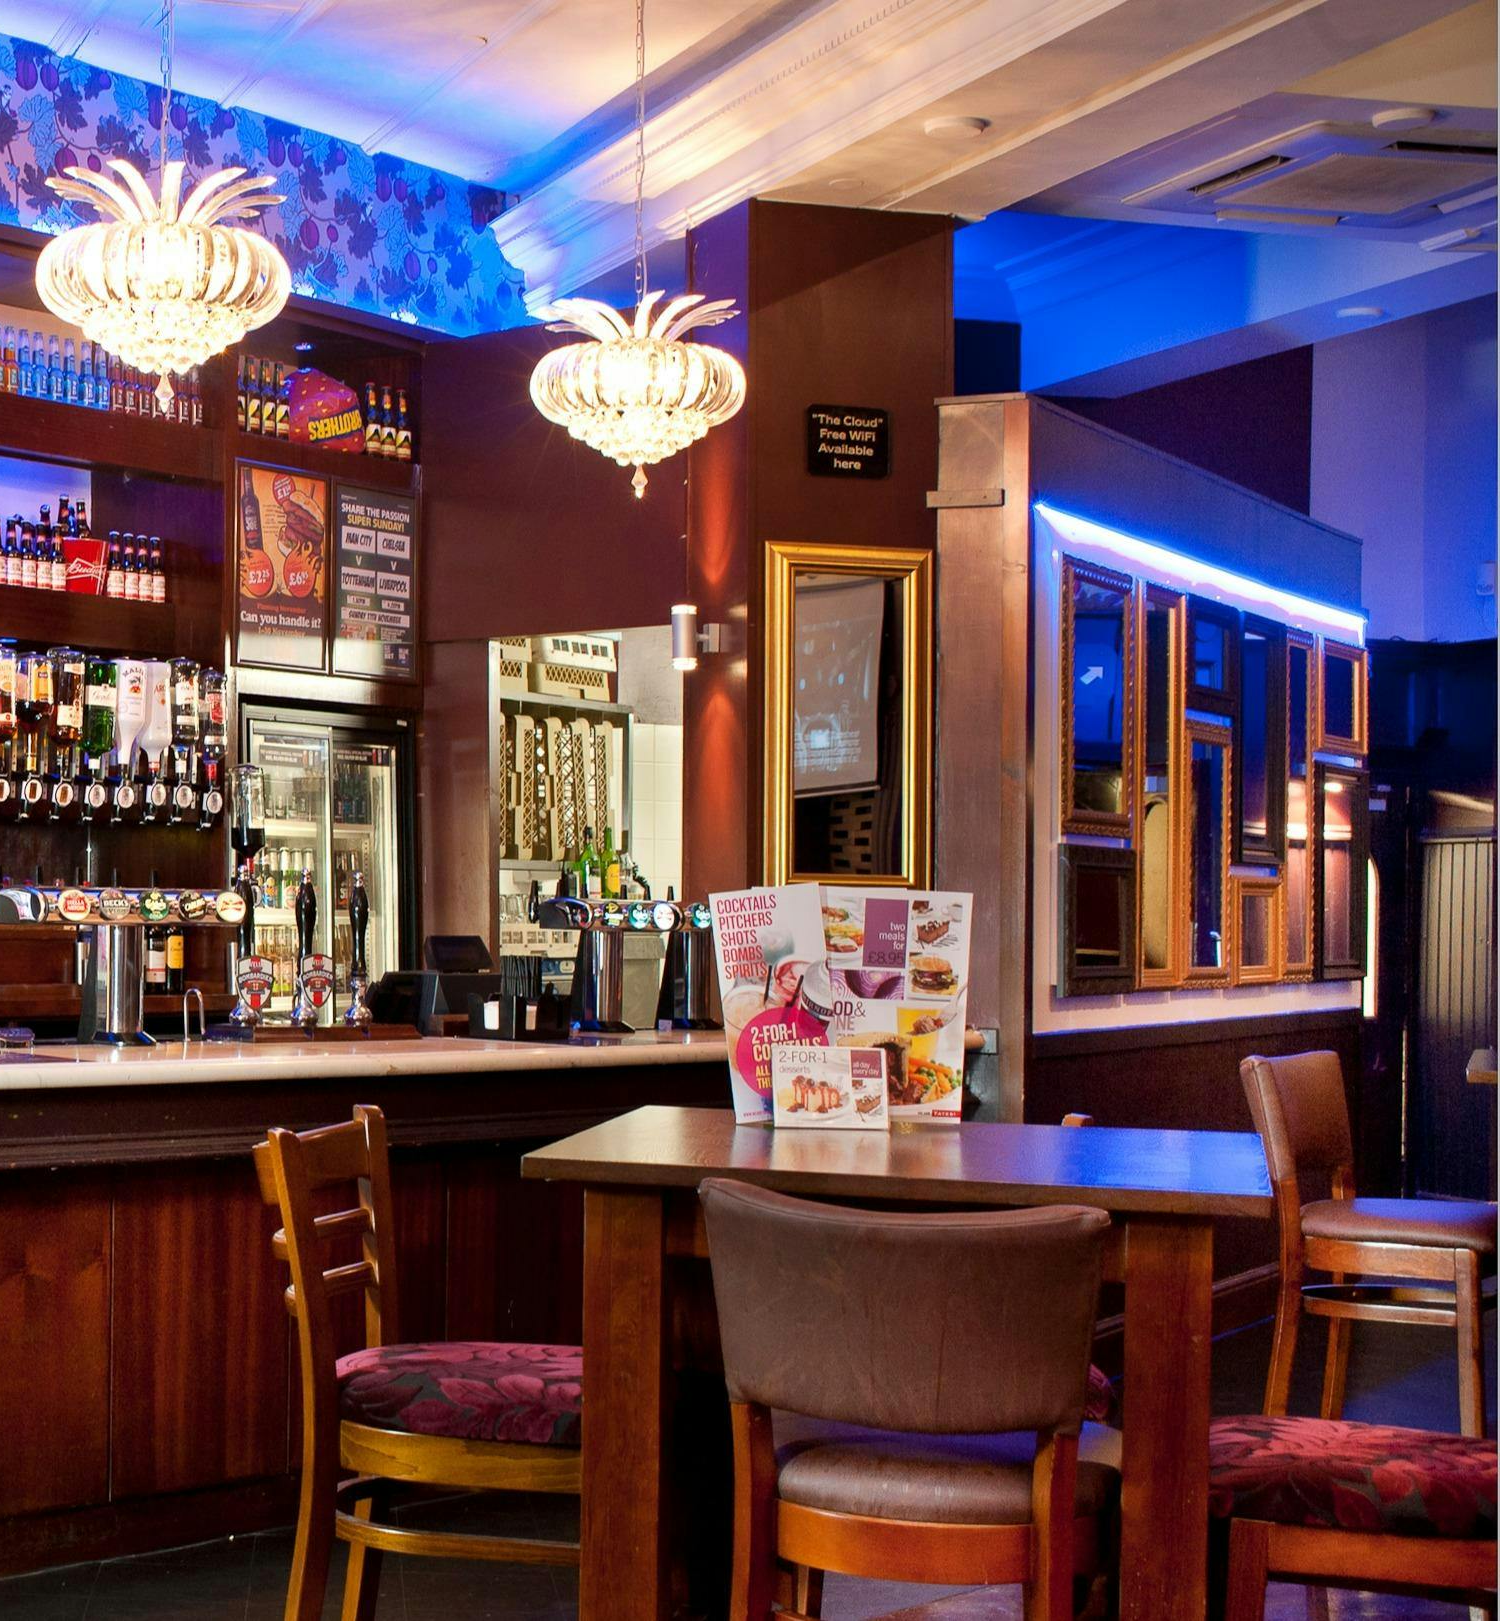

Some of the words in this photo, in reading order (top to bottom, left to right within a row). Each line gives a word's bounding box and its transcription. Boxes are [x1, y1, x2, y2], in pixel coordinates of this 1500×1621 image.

[819, 428, 846, 441] Free
[849, 430, 876, 442] WiFi
[818, 443, 874, 456] Available
[833, 458, 862, 471] here
[341, 502, 365, 515] SHARE
[366, 507, 380, 518] THE
[382, 509, 410, 523] PASSION
[348, 514, 371, 526] SUPER
[373, 518, 405, 532] SUNDAY!
[360, 535, 372, 547] CITY
[356, 555, 362, 566] V
[391, 561, 397, 571] V
[240, 611, 258, 623] Can
[259, 613, 277, 625] you
[278, 614, 310, 628] handle
[310, 616, 322, 628] it?
[717, 894, 776, 915] COCKTAILS
[719, 912, 772, 931] PITCHERS
[890, 922, 905, 931] two
[721, 930, 757, 947] SHOTS
[879, 931, 905, 941] meals
[893, 940, 905, 950] for
[723, 946, 763, 964] BOMBS
[725, 961, 768, 980] SPIRITS
[751, 1022, 796, 1044] 2-FOR-1
[779, 1051, 827, 1063] 2-FOR-1
[756, 1066, 770, 1077] ALL
[779, 1065, 811, 1074] desserts
[853, 1068, 869, 1077] every
[869, 1068, 880, 1077] day
[860, 1062, 871, 1070] day
